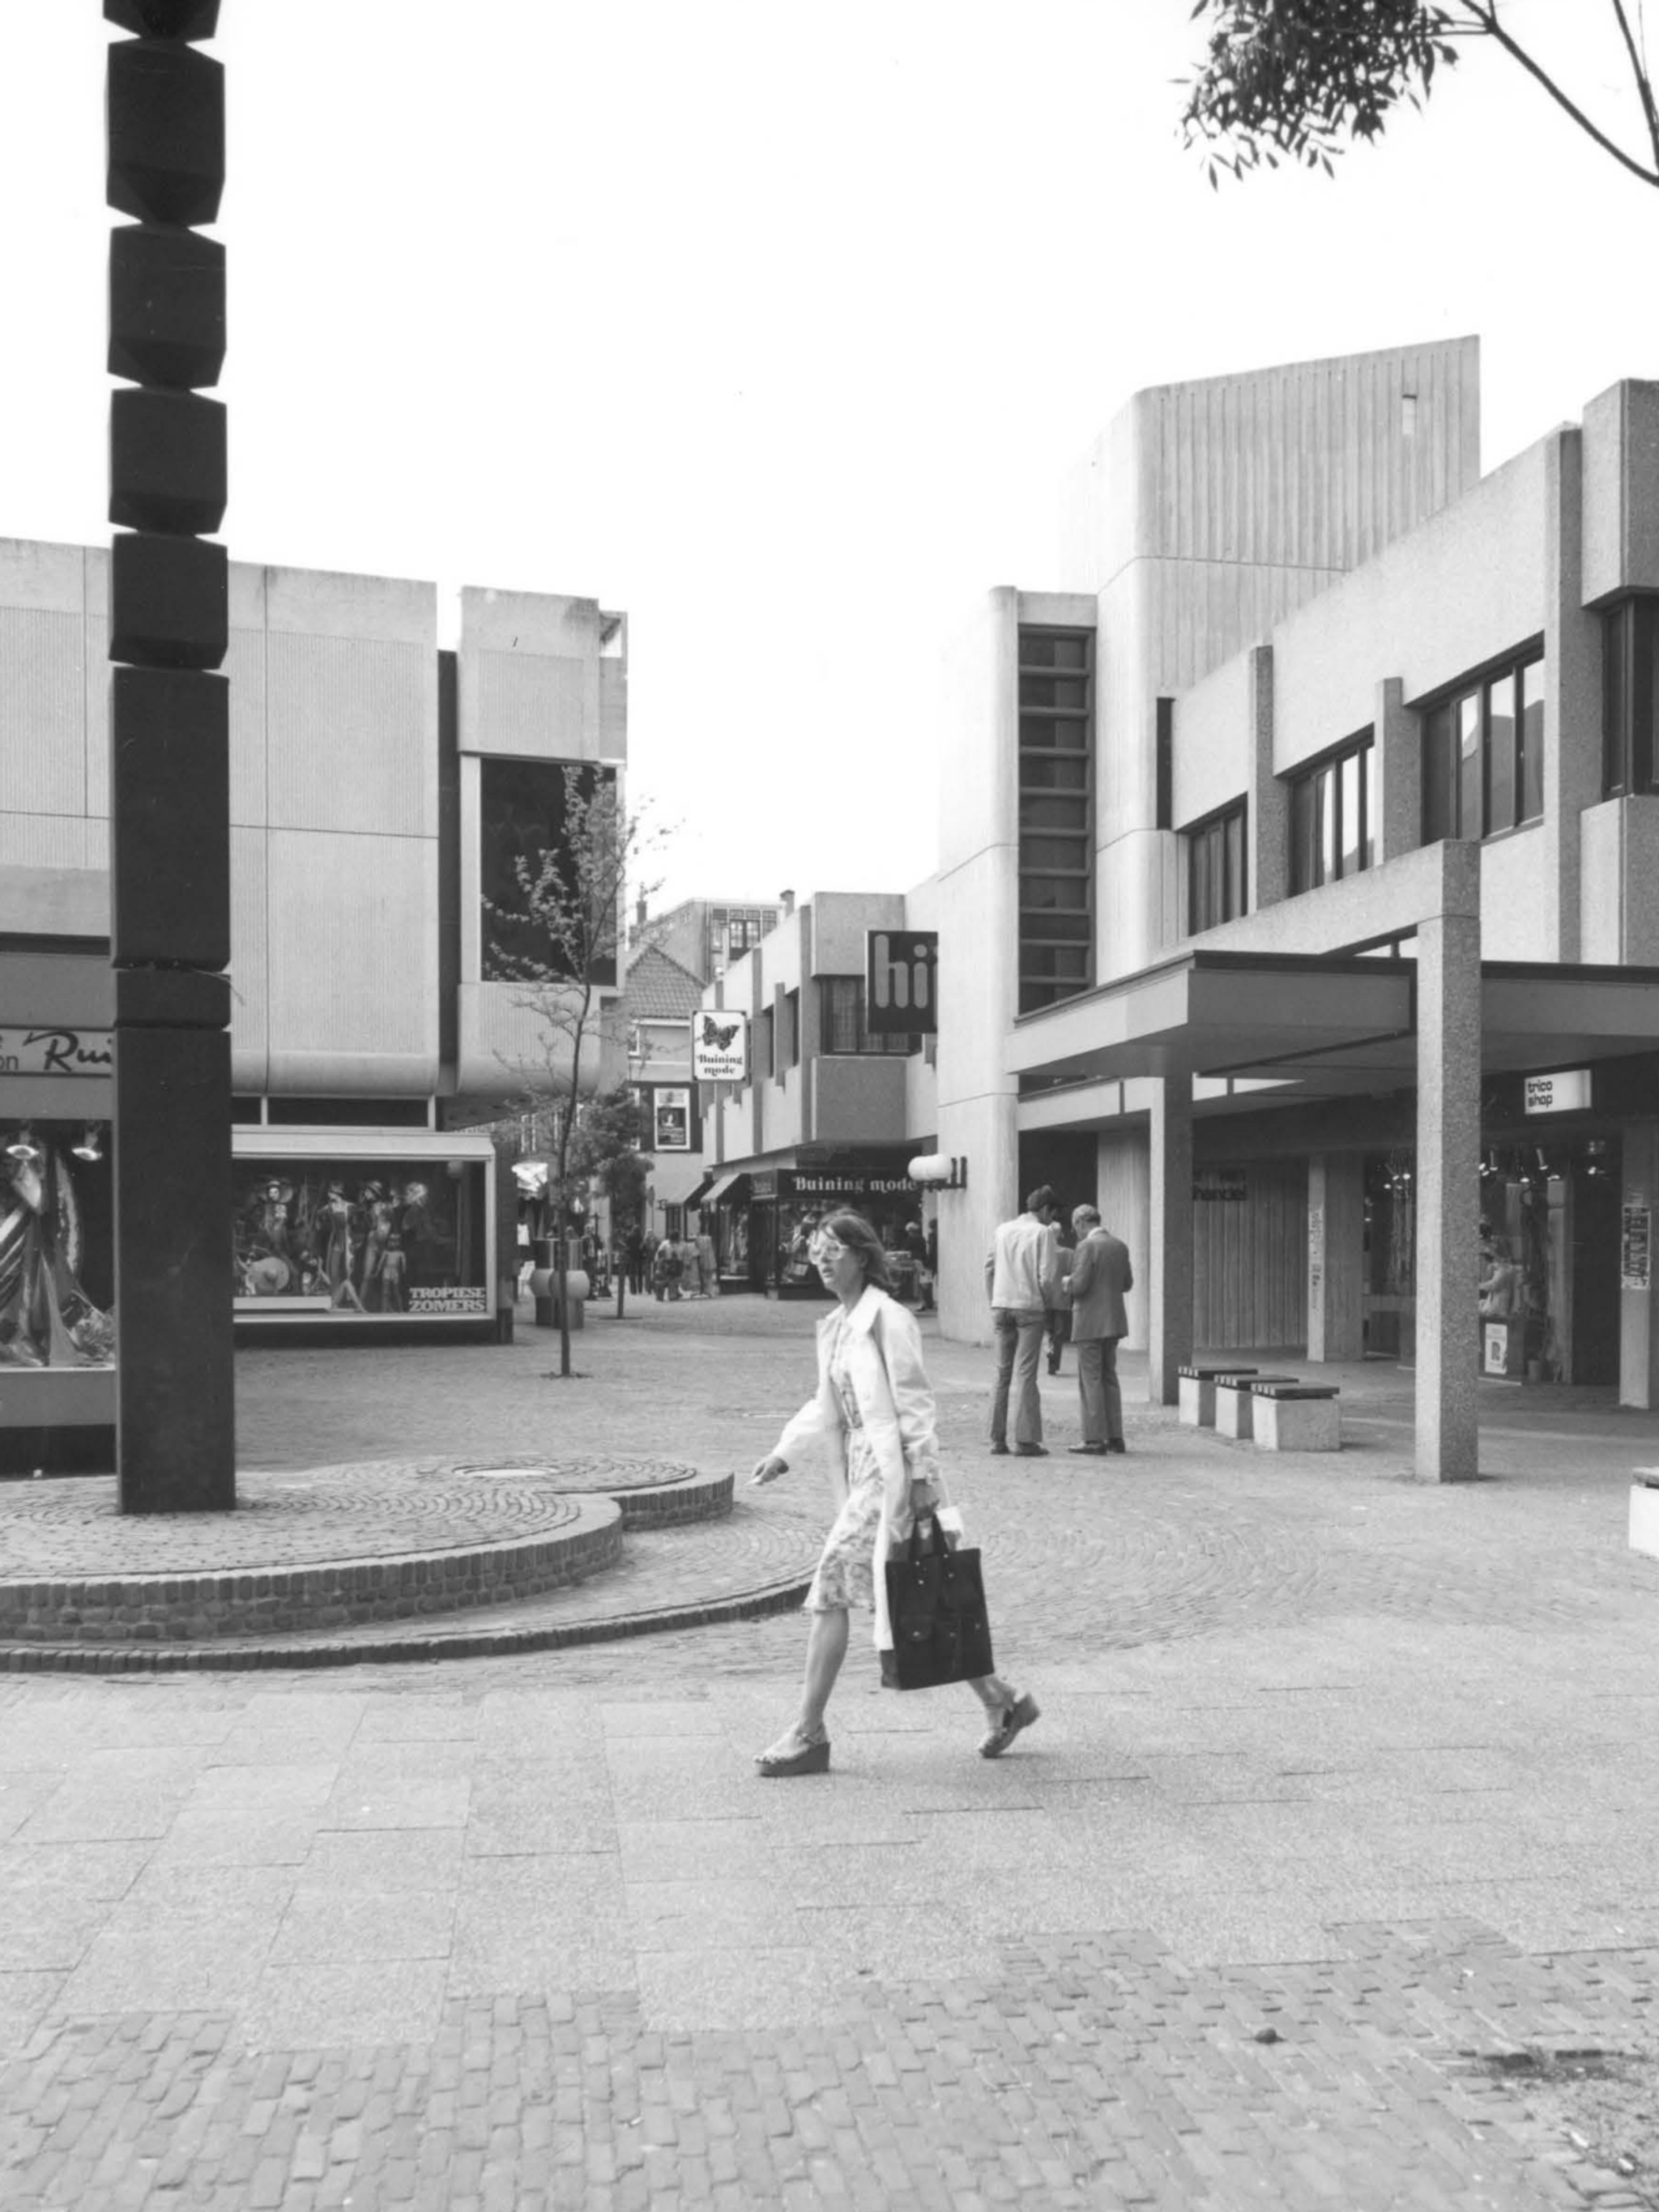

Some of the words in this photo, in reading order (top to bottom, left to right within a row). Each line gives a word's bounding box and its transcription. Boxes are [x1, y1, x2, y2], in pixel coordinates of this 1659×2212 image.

[697, 1054, 742, 1066] Buining
[704, 1065, 736, 1076] mode
[1528, 1079, 1553, 1093] trico
[1528, 1093, 1553, 1108] shop
[791, 1176, 864, 1193] Buining
[870, 1176, 918, 1194] mode
[409, 1287, 486, 1298] TROPIESE
[409, 1300, 486, 1312] ZOMERS
